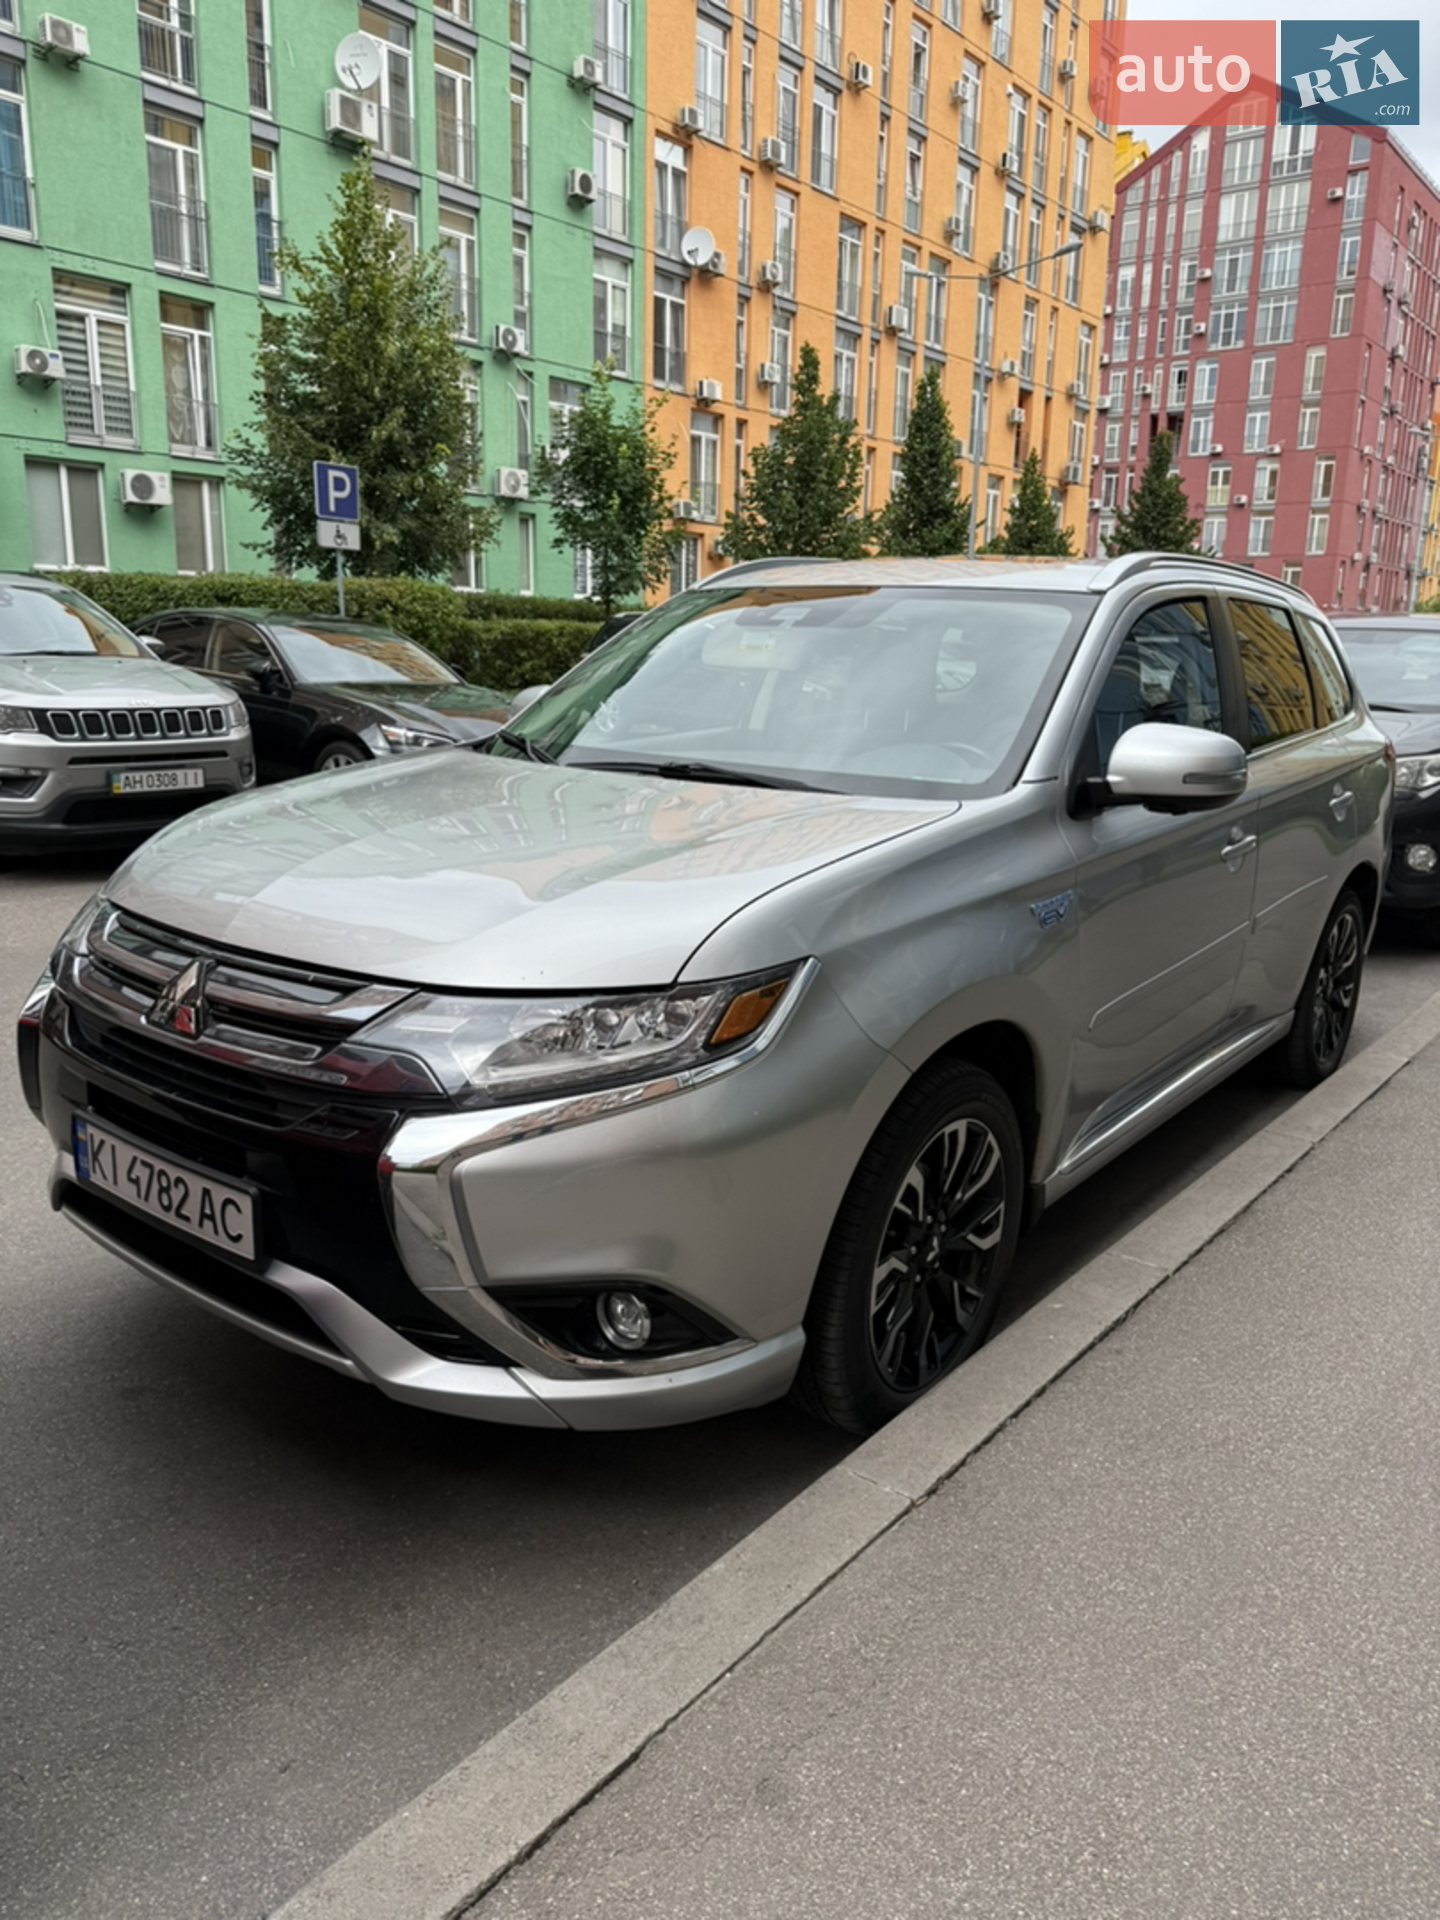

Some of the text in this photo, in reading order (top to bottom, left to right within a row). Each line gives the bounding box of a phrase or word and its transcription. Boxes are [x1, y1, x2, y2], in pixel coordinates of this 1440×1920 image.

[327, 468, 352, 513] P
[122, 774, 145, 790] AH
[145, 772, 179, 788] 0308
[89, 1132, 244, 1243] KI 4782 AC
